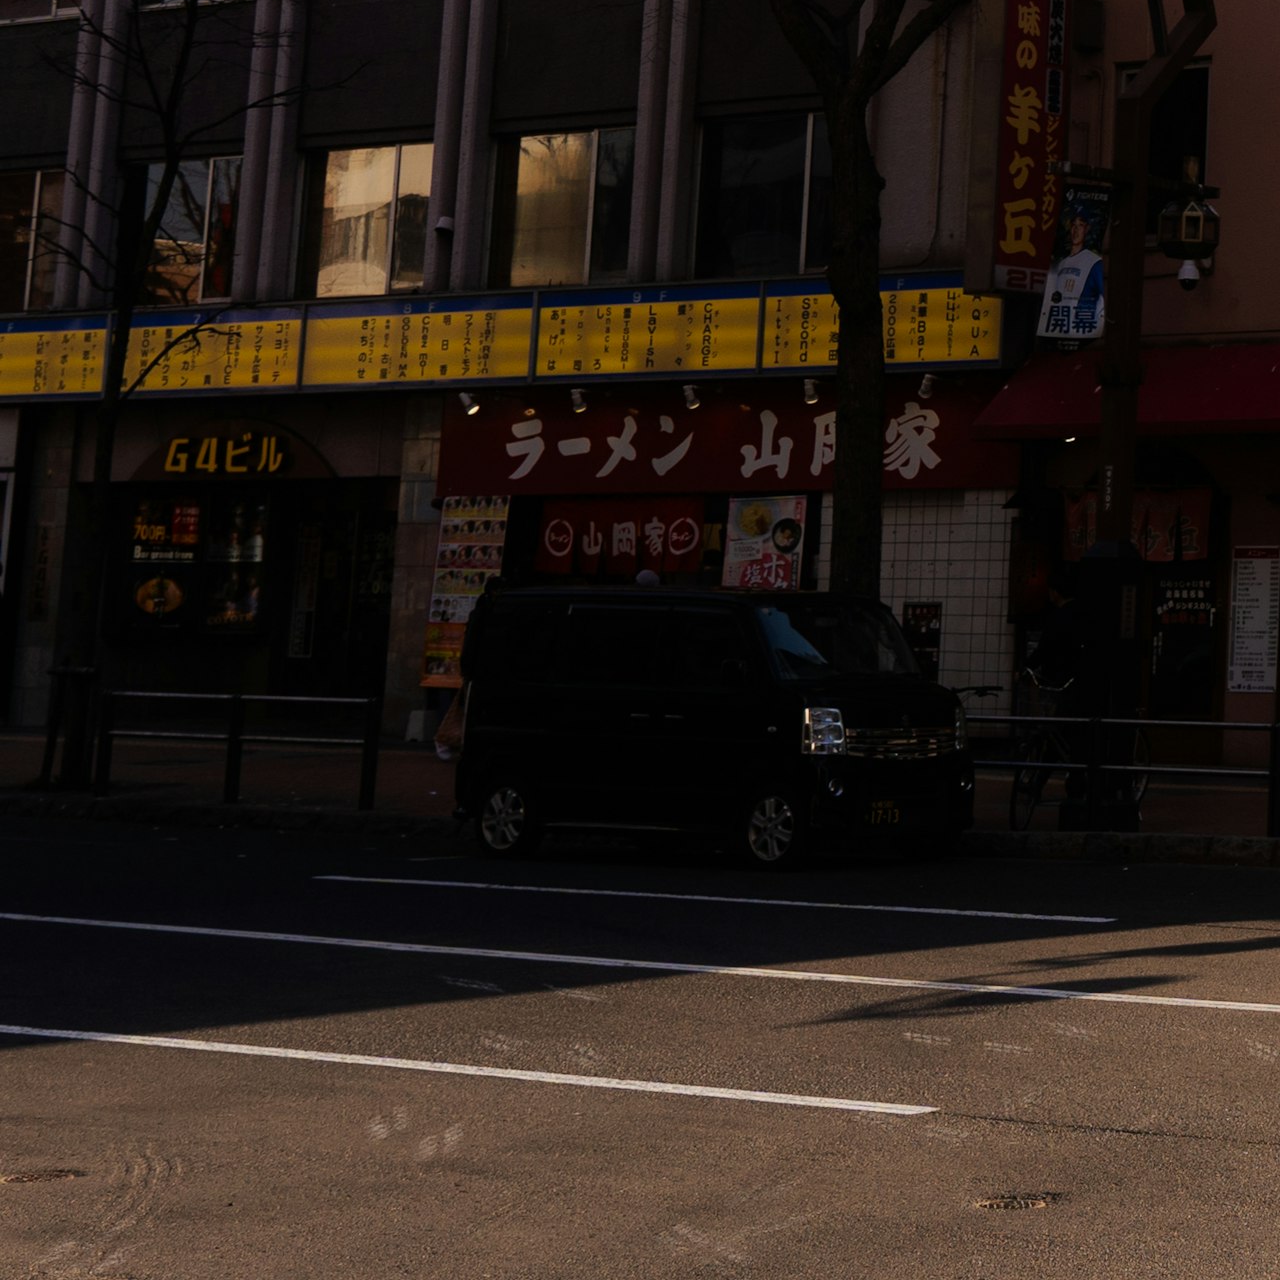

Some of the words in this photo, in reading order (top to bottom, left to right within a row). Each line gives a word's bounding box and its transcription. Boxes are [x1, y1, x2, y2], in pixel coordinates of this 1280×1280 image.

[1000, 1, 1043, 259] 味の羊ヶ丘
[1076, 191, 1109, 201] FIGHTERS
[1006, 268, 1046, 291] 2F
[399, 317, 411, 360] GOLDEN
[484, 312, 493, 341] Star
[546, 309, 560, 371] あげは
[603, 307, 612, 353] Snack
[645, 305, 657, 368] Lavish
[701, 302, 713, 367] CHARGE
[799, 297, 811, 363] Second
[1045, 305, 1097, 334] 開幕
[271, 322, 285, 382] コヨーテ
[163, 431, 287, 473] G4ビル
[505, 414, 695, 481] ラーメン
[581, 515, 664, 556] 山岡家
[871, 808, 900, 825] 17-13
